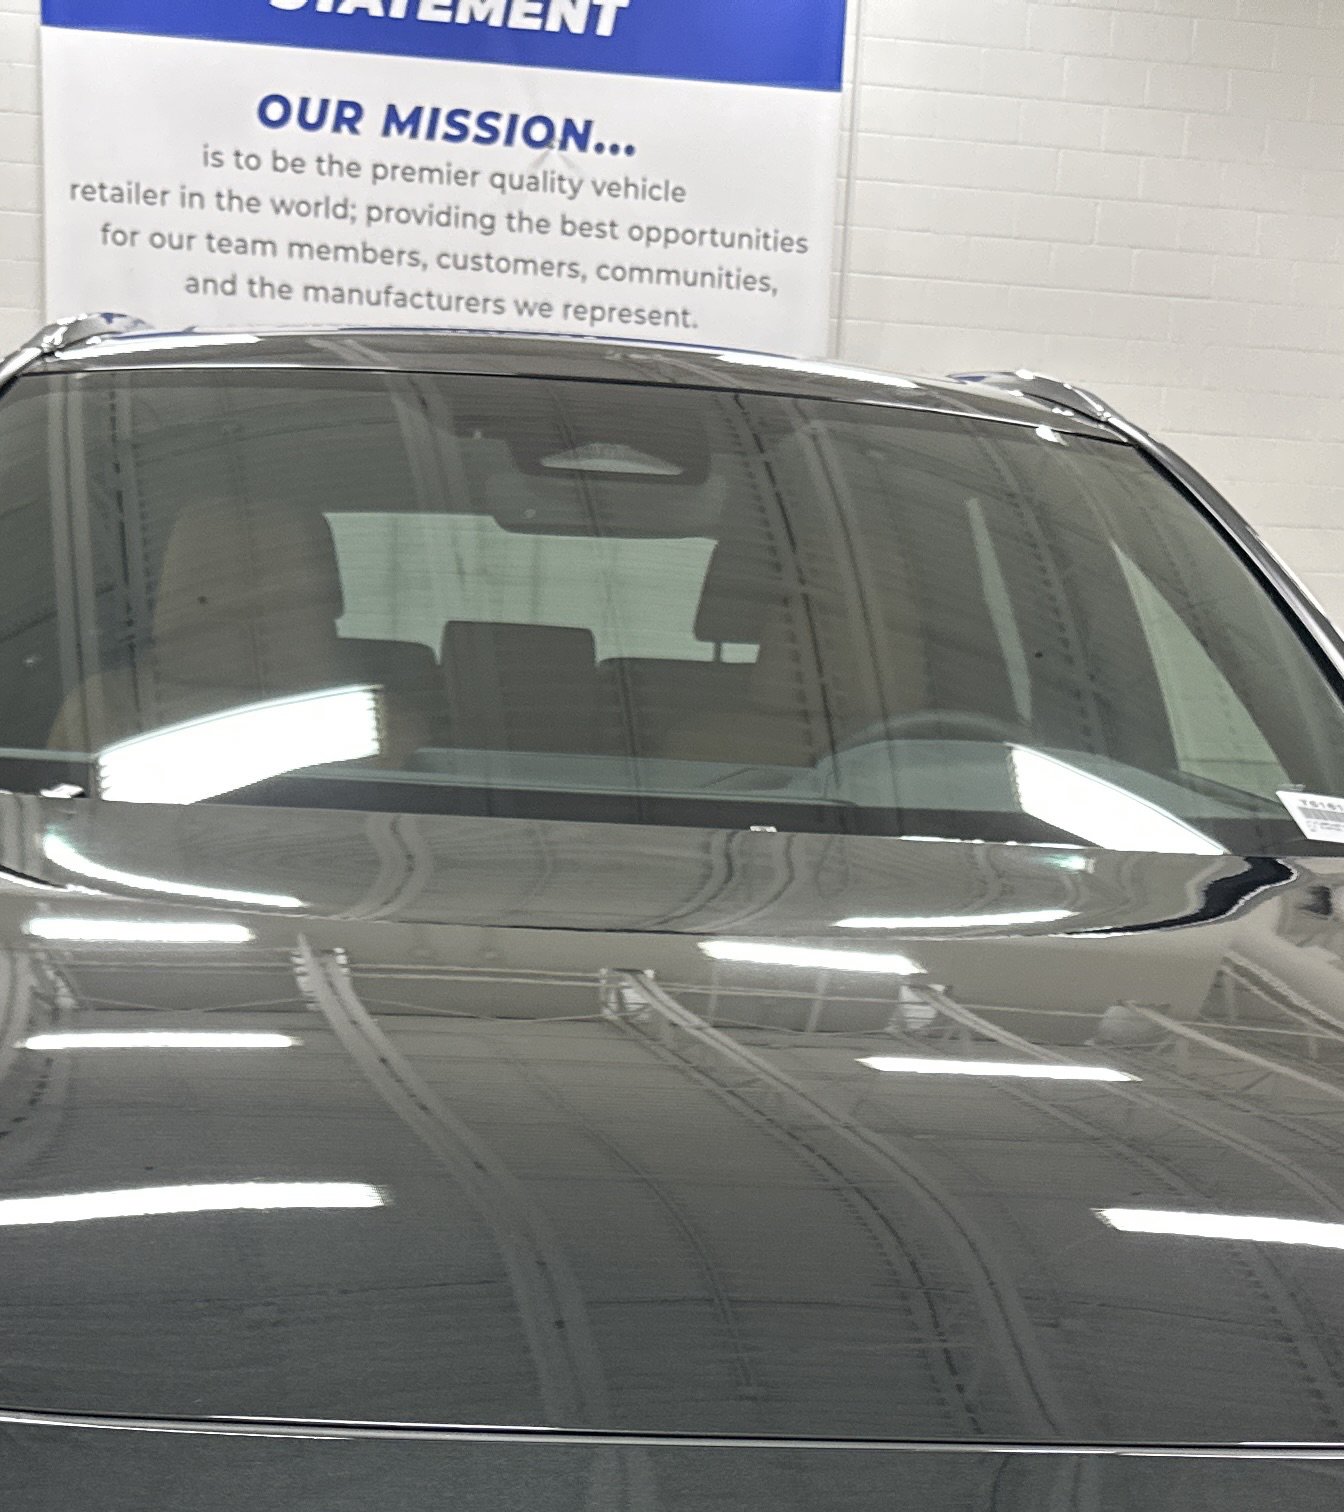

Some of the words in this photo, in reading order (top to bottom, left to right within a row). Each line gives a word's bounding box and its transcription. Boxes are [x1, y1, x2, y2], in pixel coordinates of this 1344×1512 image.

[256, 93, 365, 136] OUR
[381, 103, 636, 157] MISSION...
[203, 144, 224, 168] is
[233, 150, 262, 171] to
[272, 149, 306, 174] be
[315, 153, 362, 178] the
[372, 162, 480, 190] premier
[489, 170, 584, 200] quality
[591, 176, 686, 203] vehicle
[70, 181, 170, 206] retailer
[180, 185, 205, 210] in
[215, 189, 261, 213] the
[270, 196, 357, 224] world;
[366, 203, 496, 236] providing
[505, 209, 551, 235] the
[560, 213, 619, 240] best
[628, 224, 808, 254] opportunities
[101, 222, 140, 247] for
[149, 232, 196, 250] our
[205, 232, 277, 257] team
[288, 241, 428, 271] members,
[436, 252, 587, 283] customers,
[596, 264, 777, 296] communities,
[185, 273, 237, 296] and
[247, 276, 293, 300] the
[303, 284, 505, 315] manufacturers
[514, 300, 553, 318] we
[563, 303, 698, 328] represent.
